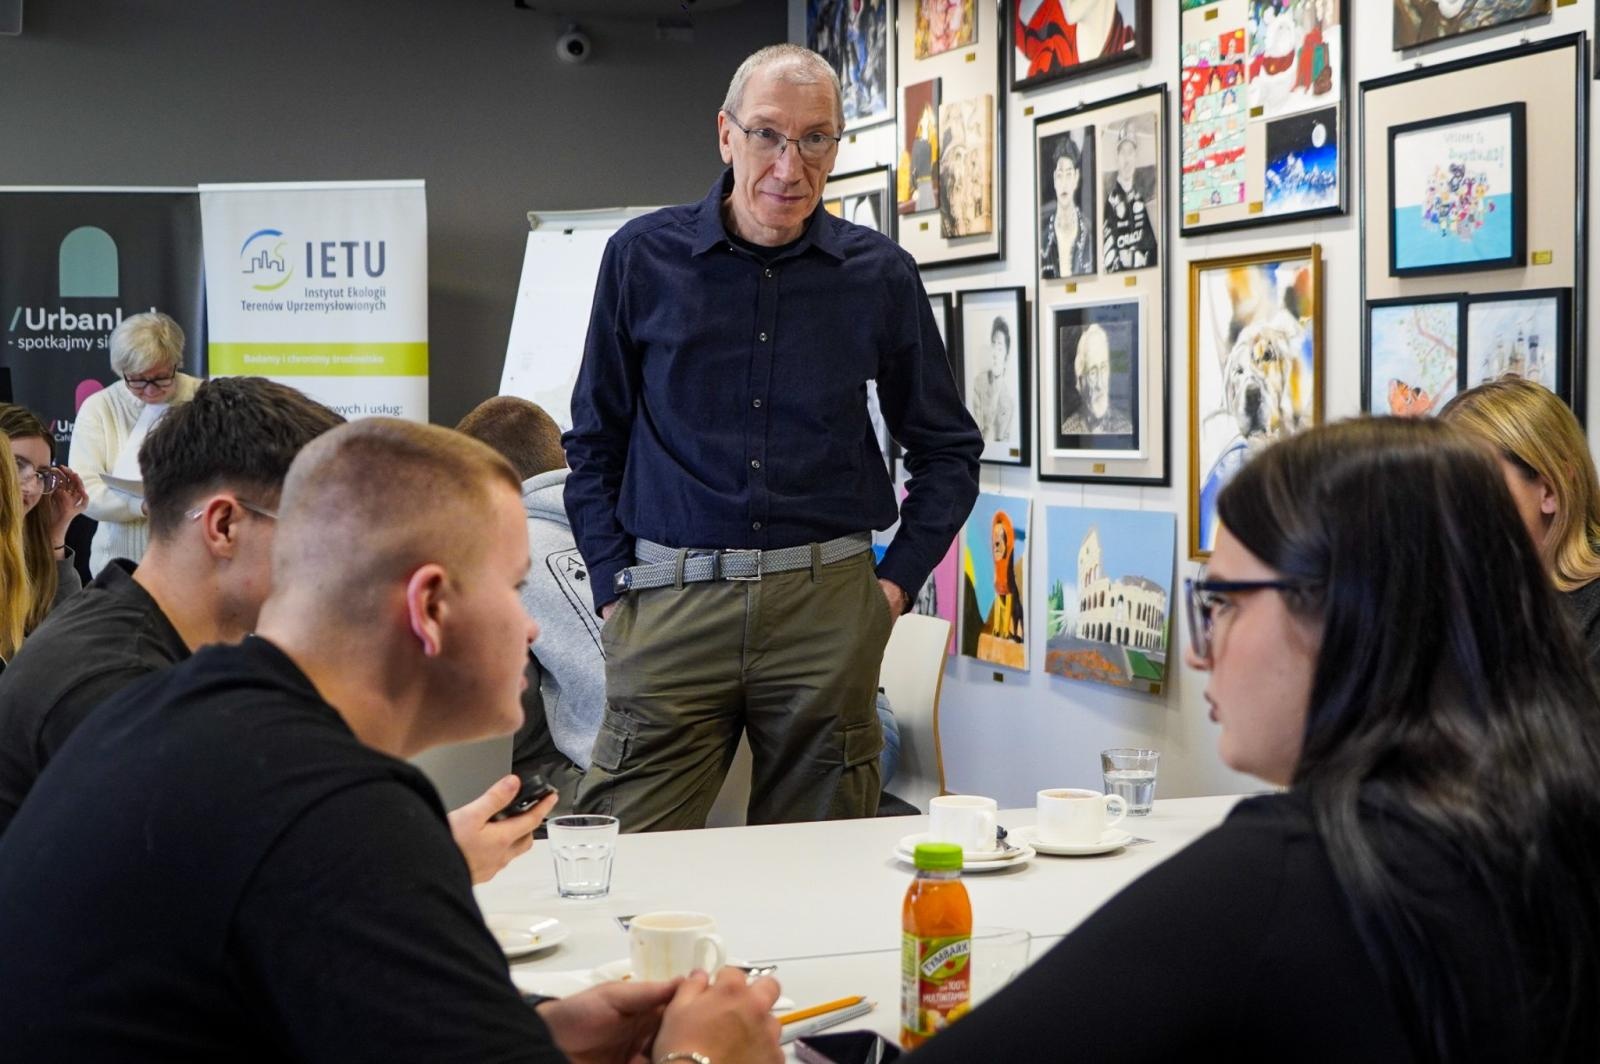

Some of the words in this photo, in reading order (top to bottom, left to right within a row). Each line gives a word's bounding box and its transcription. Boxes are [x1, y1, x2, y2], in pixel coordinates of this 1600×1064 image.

[306, 240, 386, 279] IETU
[305, 287, 344, 300] Instytut
[347, 286, 386, 300] Ekologii
[241, 300, 283, 312] Terenów
[286, 300, 386, 314] Uprzemysłowionych
[18, 335, 93, 351] spotkajmy
[97, 335, 110, 349] si
[370, 403, 403, 416] usług:
[566, 556, 584, 572] A
